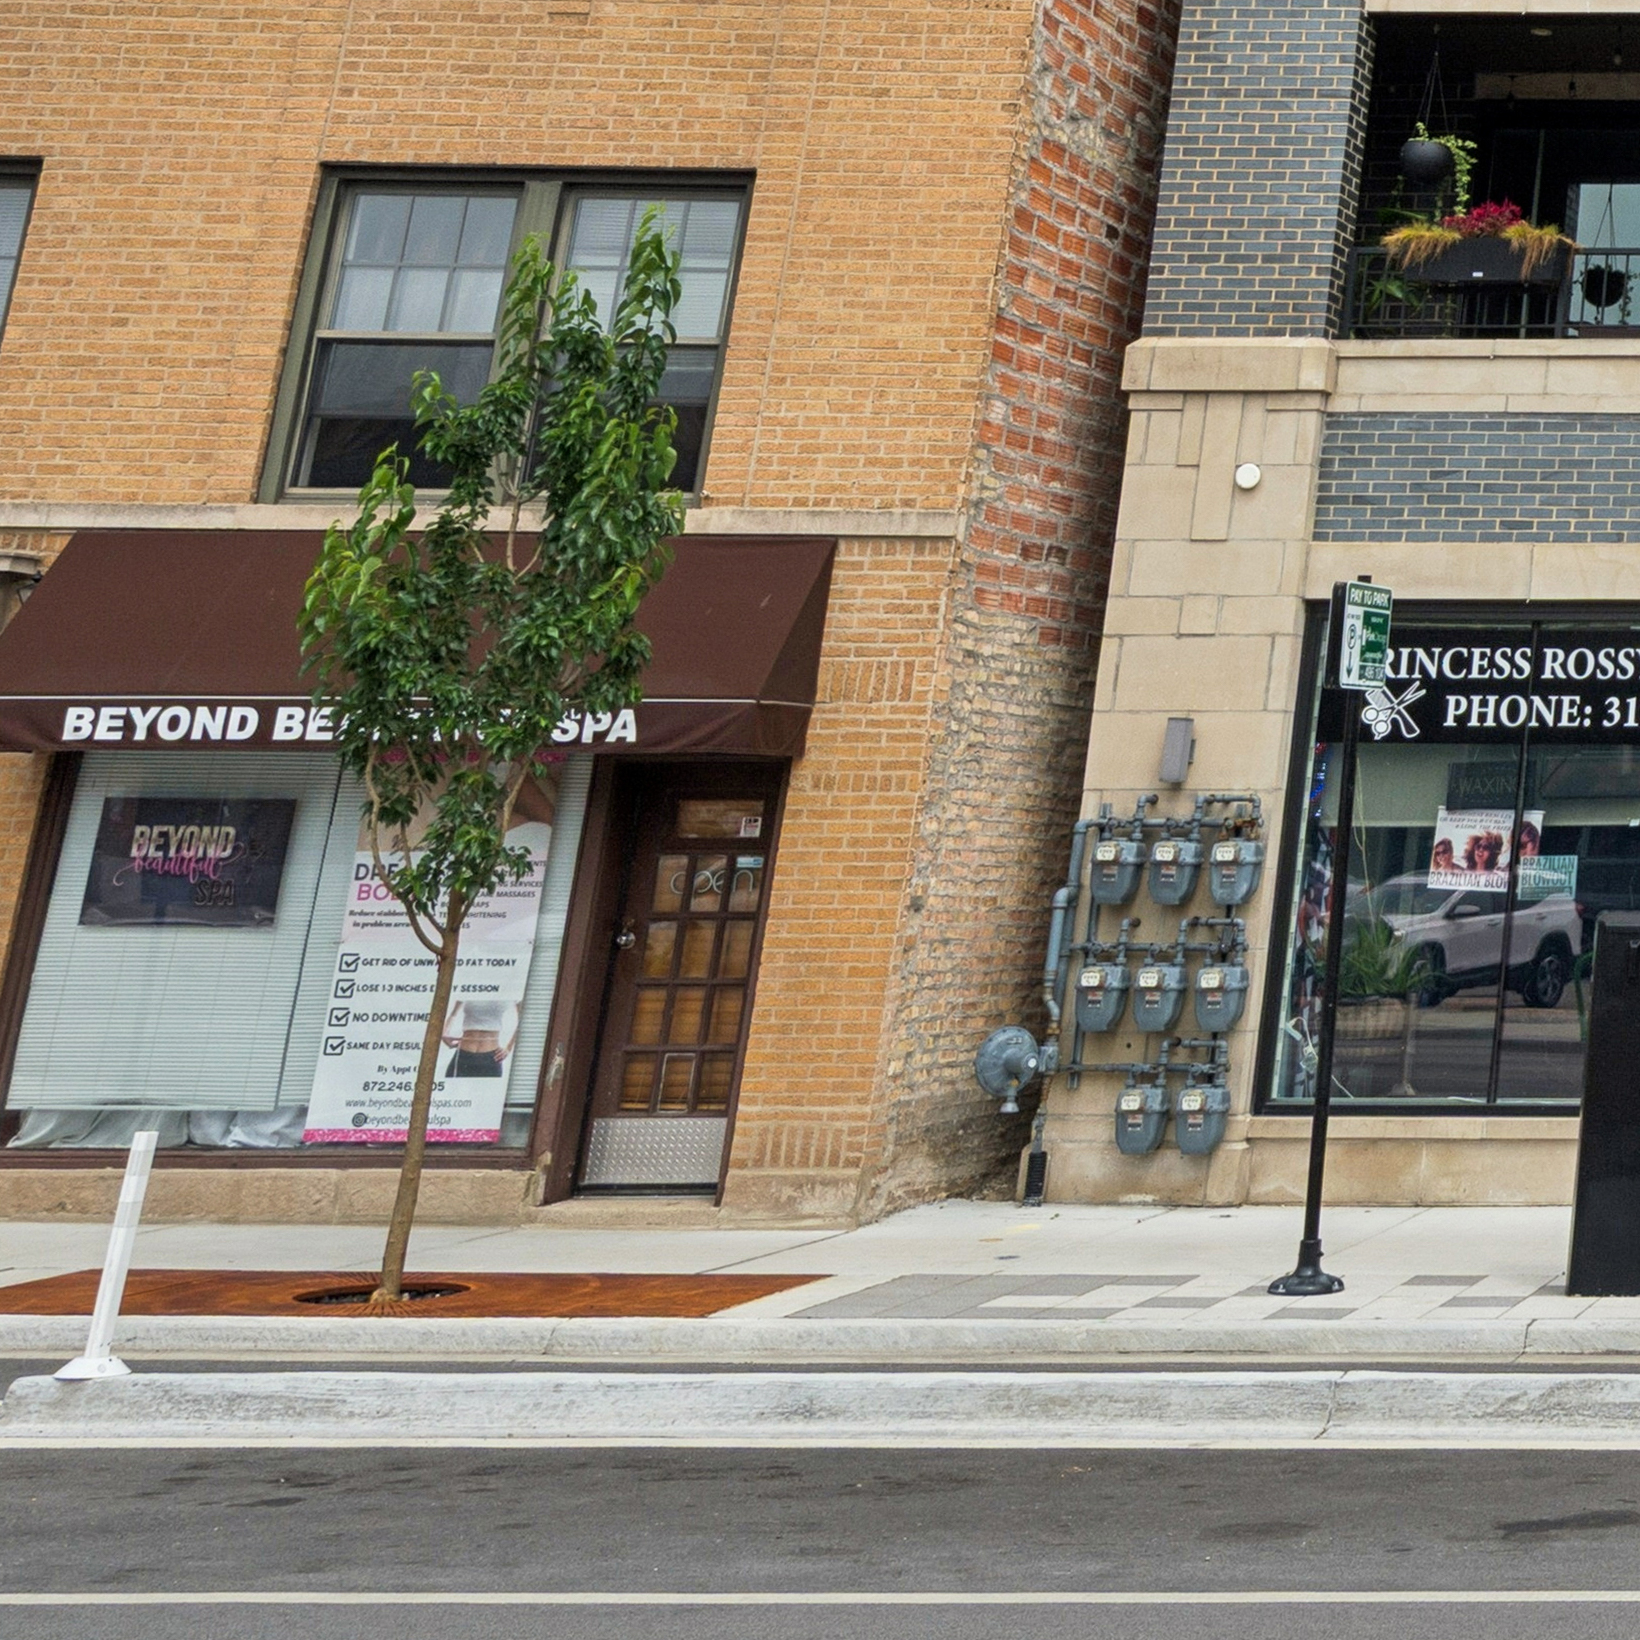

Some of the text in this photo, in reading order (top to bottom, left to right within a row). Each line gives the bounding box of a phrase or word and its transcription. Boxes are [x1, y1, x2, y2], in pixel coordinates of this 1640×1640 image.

[1385, 648, 1532, 680] RINCESS
[62, 706, 260, 741] BEYOND
[551, 708, 637, 743] SPA
[1443, 695, 1592, 727] PHONE:
[130, 825, 237, 858] BEYOND
[194, 878, 235, 906] SPA
[361, 958, 378, 967] GET
[382, 958, 398, 967] RID
[399, 958, 411, 967] OF
[485, 959, 517, 967] TODAY
[356, 984, 380, 993] LOSE
[395, 984, 428, 993] INCHES
[460, 985, 499, 993] SESSION
[352, 1013, 431, 1022] NO DOWNTIME
[346, 1041, 369, 1050] SAME
[372, 1041, 391, 1050] DAY
